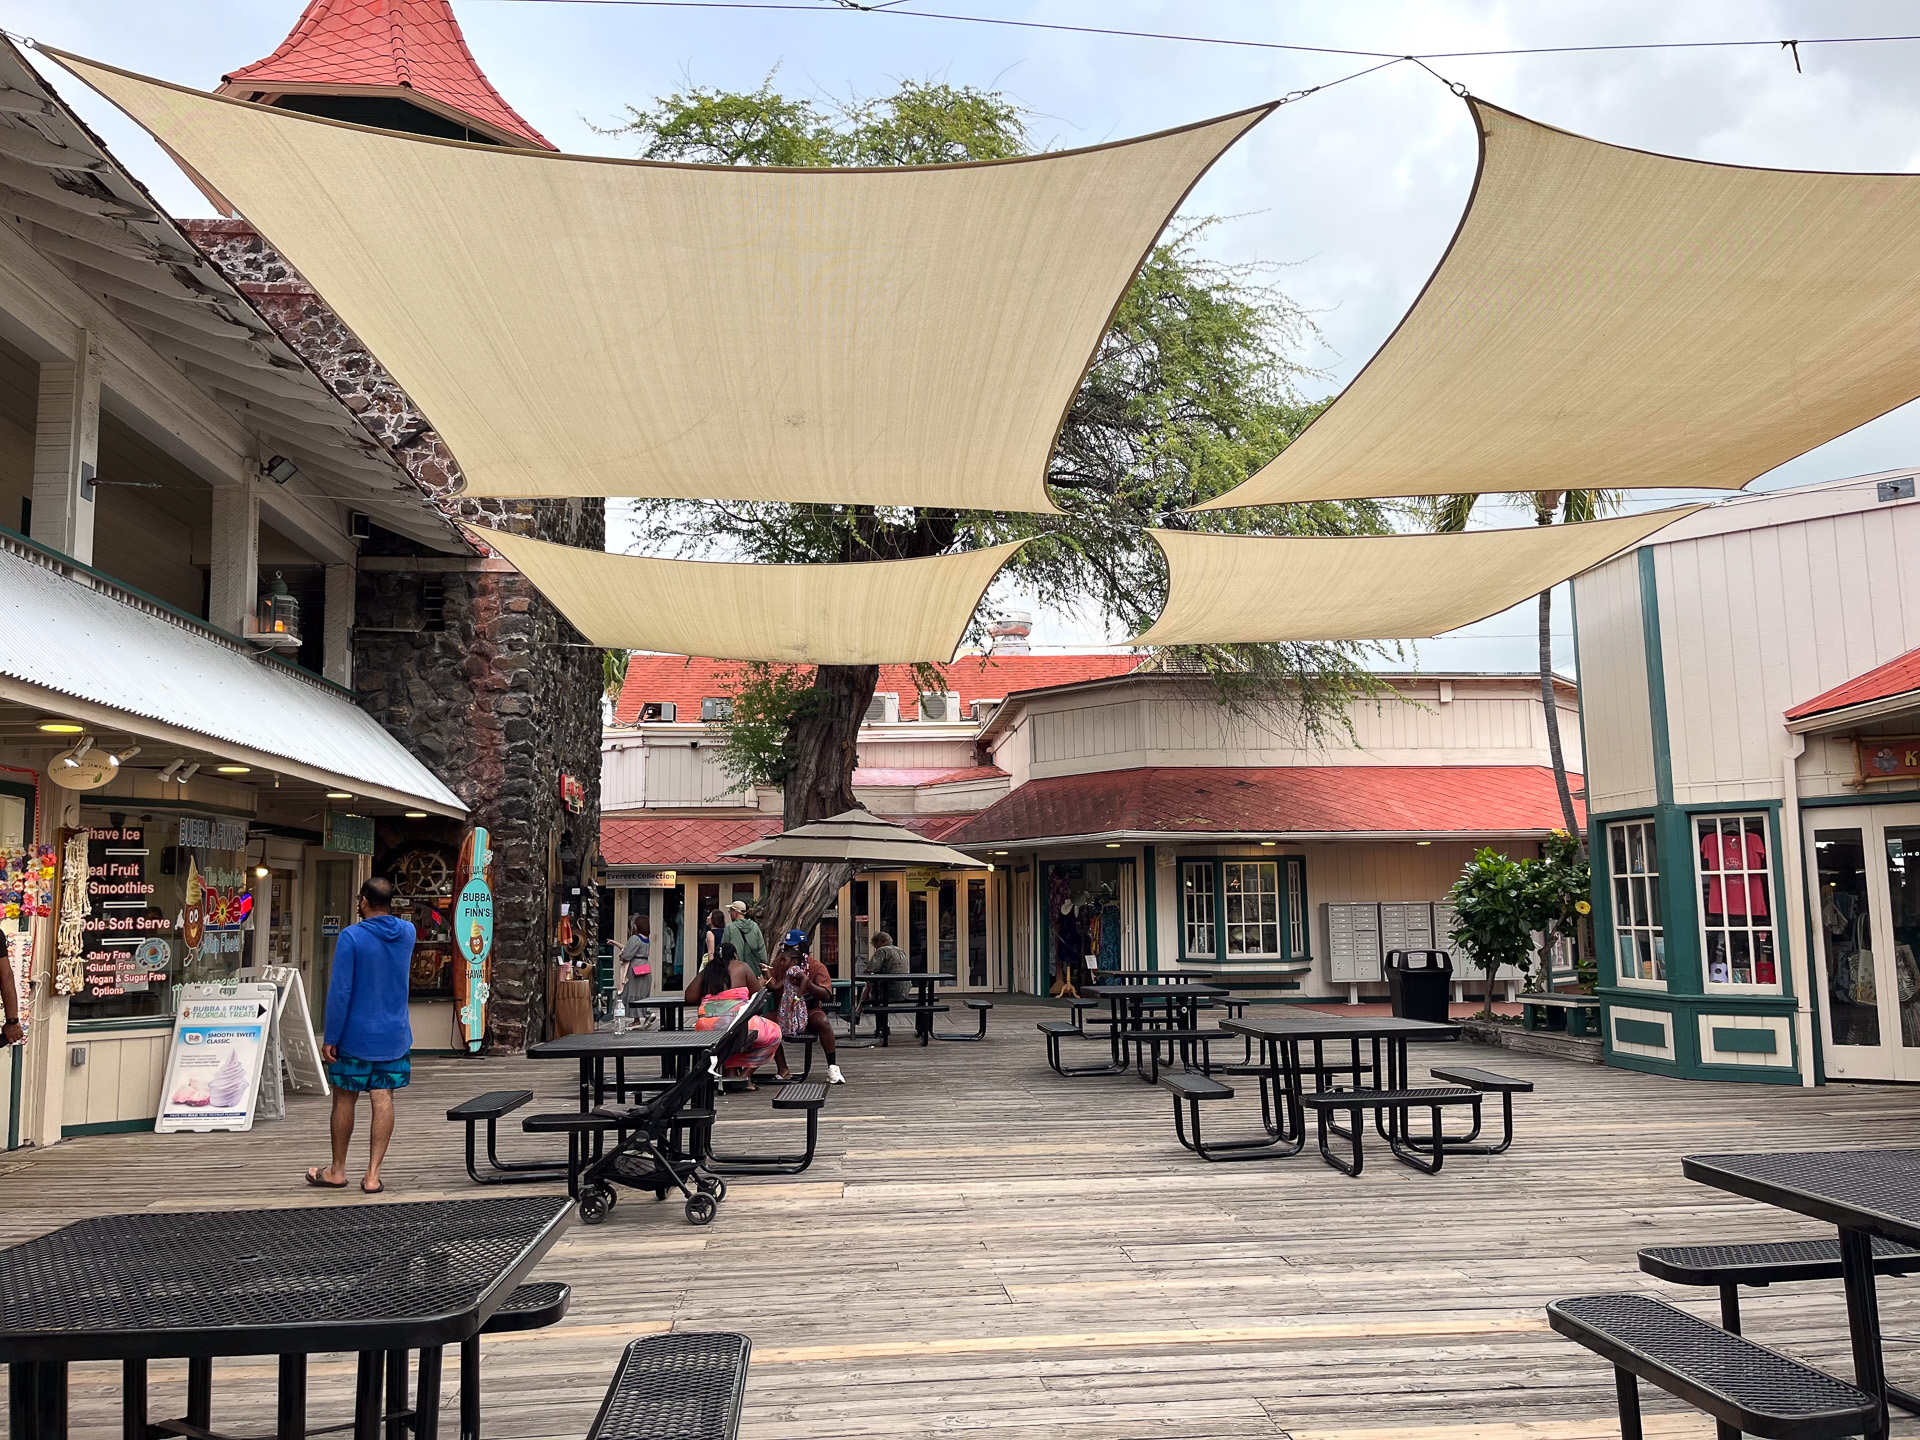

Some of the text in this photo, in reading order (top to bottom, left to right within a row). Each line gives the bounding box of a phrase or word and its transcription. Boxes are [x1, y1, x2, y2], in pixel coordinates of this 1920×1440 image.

[122, 827, 141, 840] Ice
[179, 817, 210, 848] BUBBA
[211, 823, 217, 848] &
[217, 822, 242, 851] FINN'S
[357, 838, 374, 854] TREATS
[89, 863, 140, 876] eal Fruit
[205, 866, 243, 892] The Spot for
[89, 881, 154, 894] Smoothies
[462, 893, 491, 902] BUBBA
[205, 887, 242, 924] Dole
[465, 907, 491, 917] FINN'S
[109, 917, 133, 929] Soft
[136, 916, 171, 929] Serve
[324, 917, 339, 925] OPEN
[89, 951, 131, 961] Dairy Free
[89, 962, 136, 972] Gluten Free
[88, 972, 167, 985] Vegan & Sugar Free
[92, 986, 124, 998] Options
[192, 1010, 257, 1019] TROPICAL TREATS
